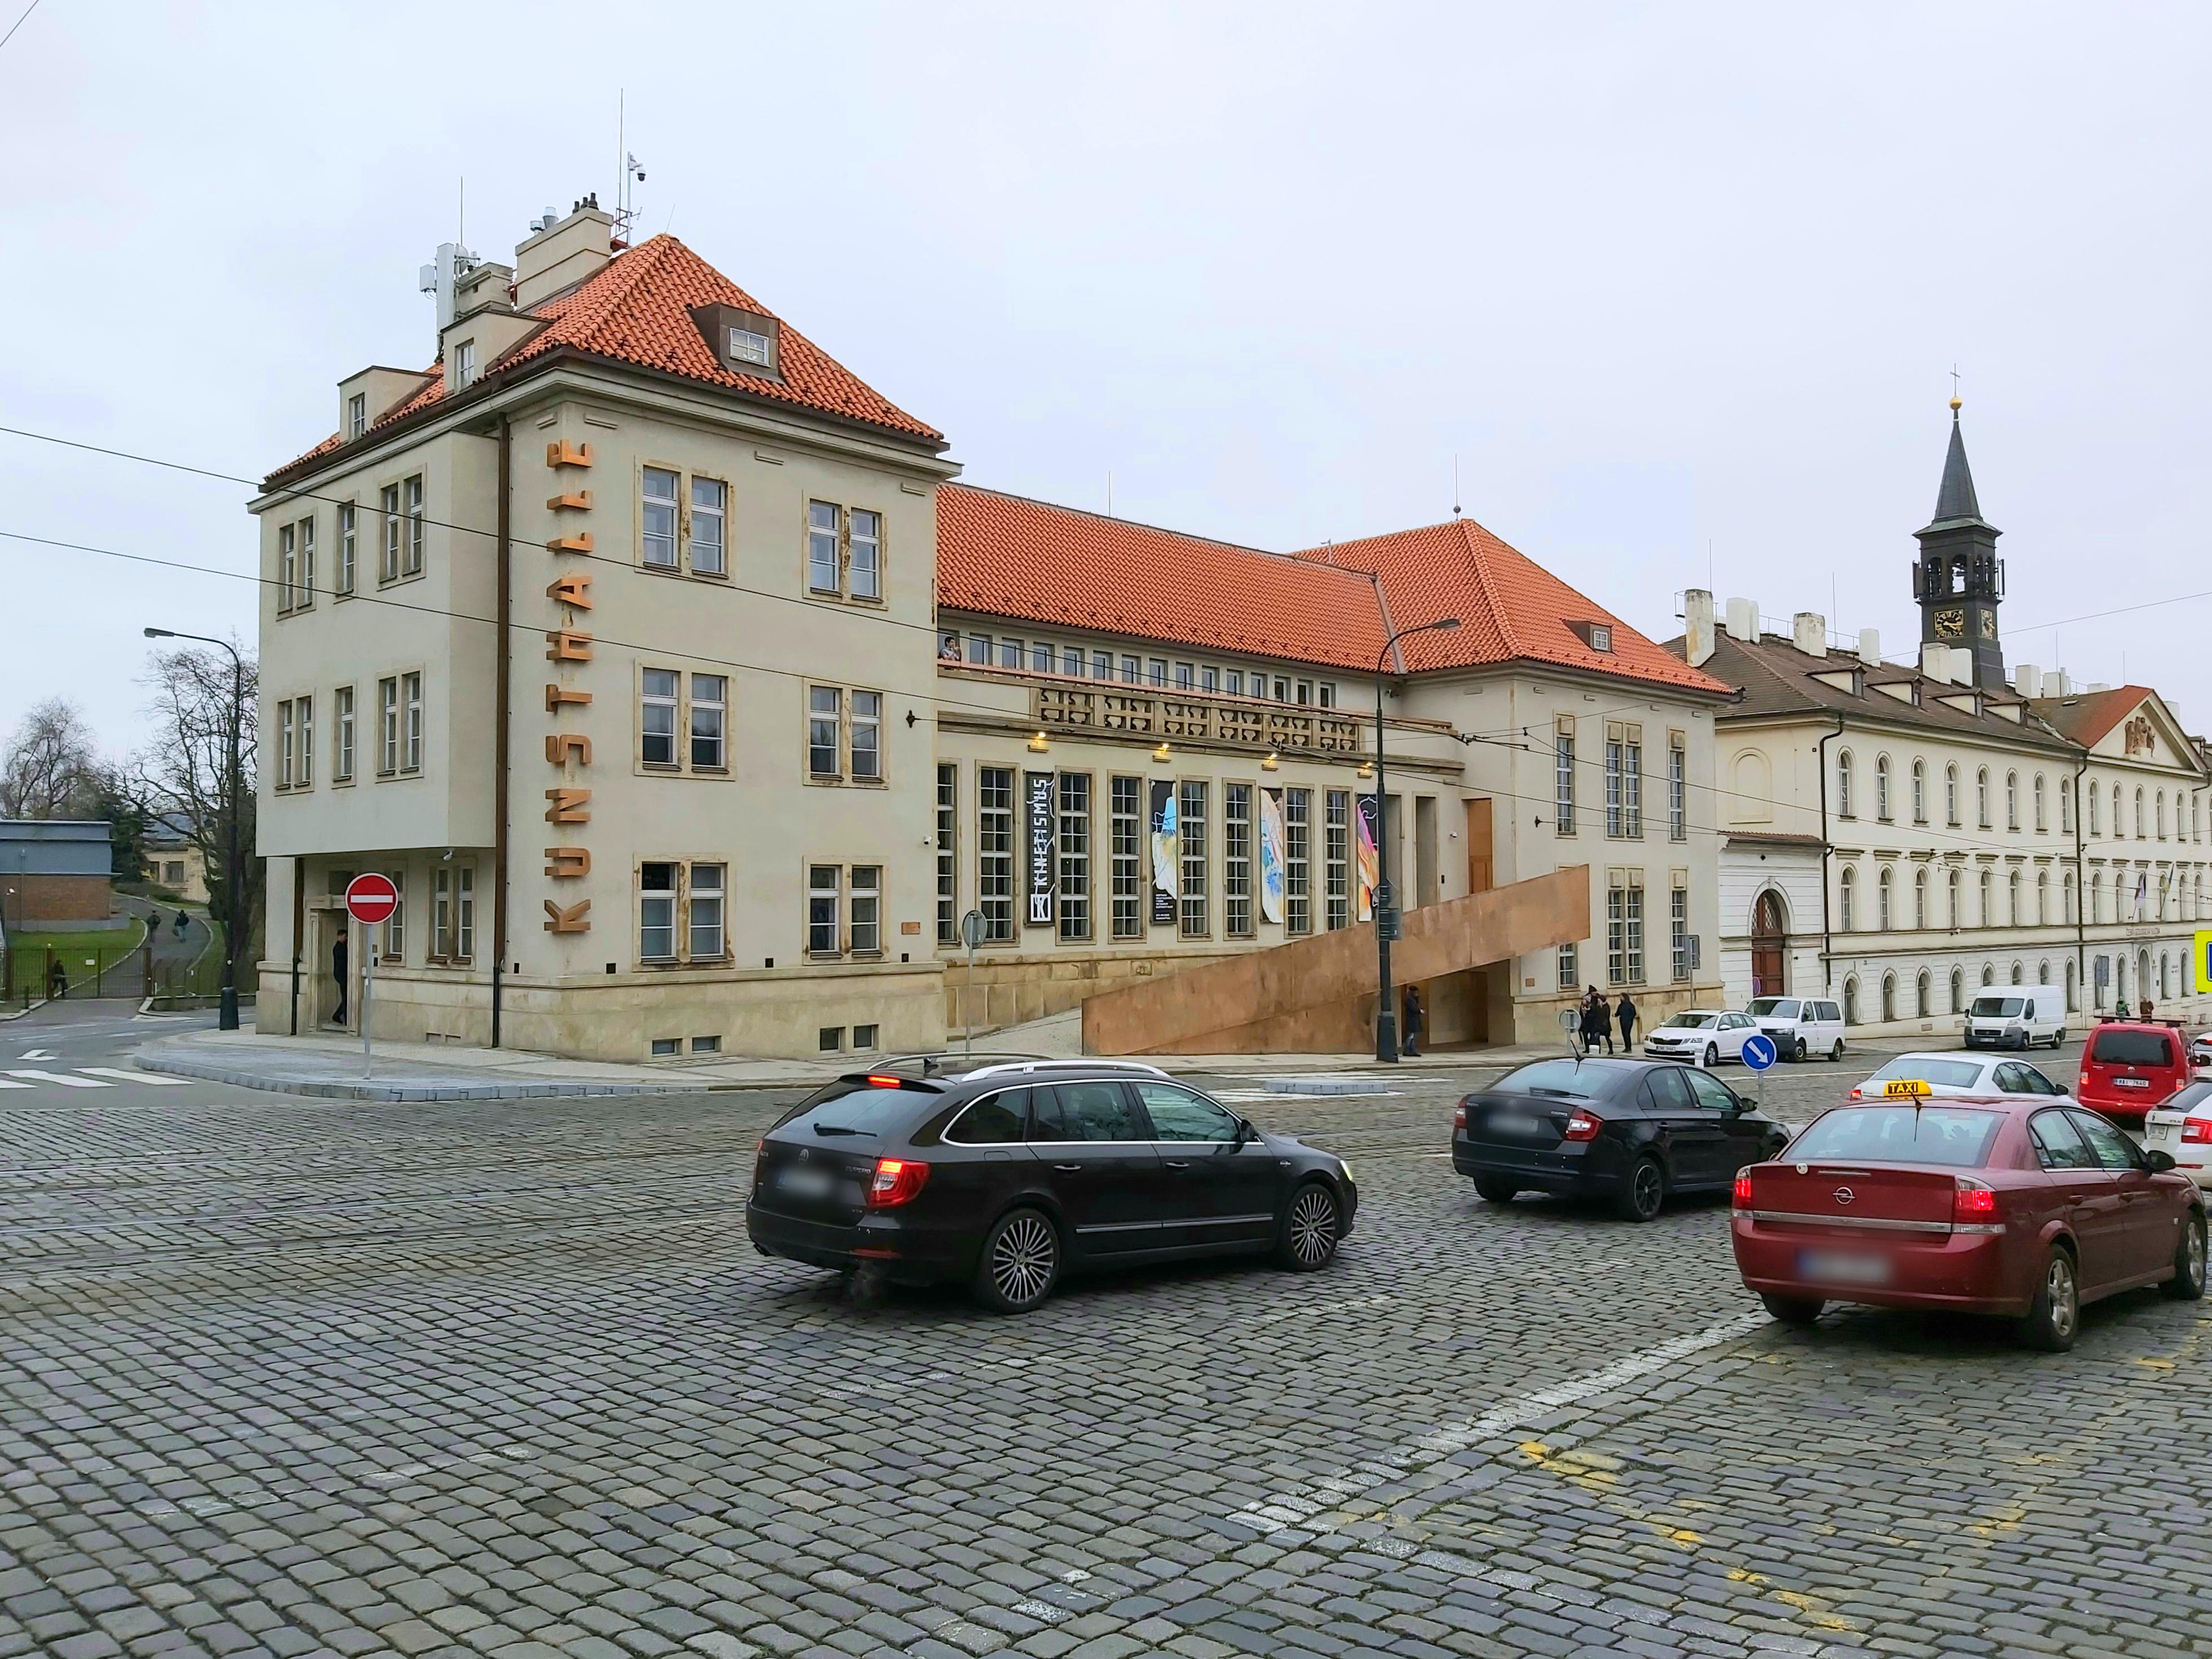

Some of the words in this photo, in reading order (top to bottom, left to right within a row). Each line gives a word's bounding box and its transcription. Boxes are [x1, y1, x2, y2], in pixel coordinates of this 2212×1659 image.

[545, 439, 593, 933] KUNSTHALLE
[1033, 779, 1047, 886] KINETISMUS
[1889, 1083, 1917, 1093] TAXI
